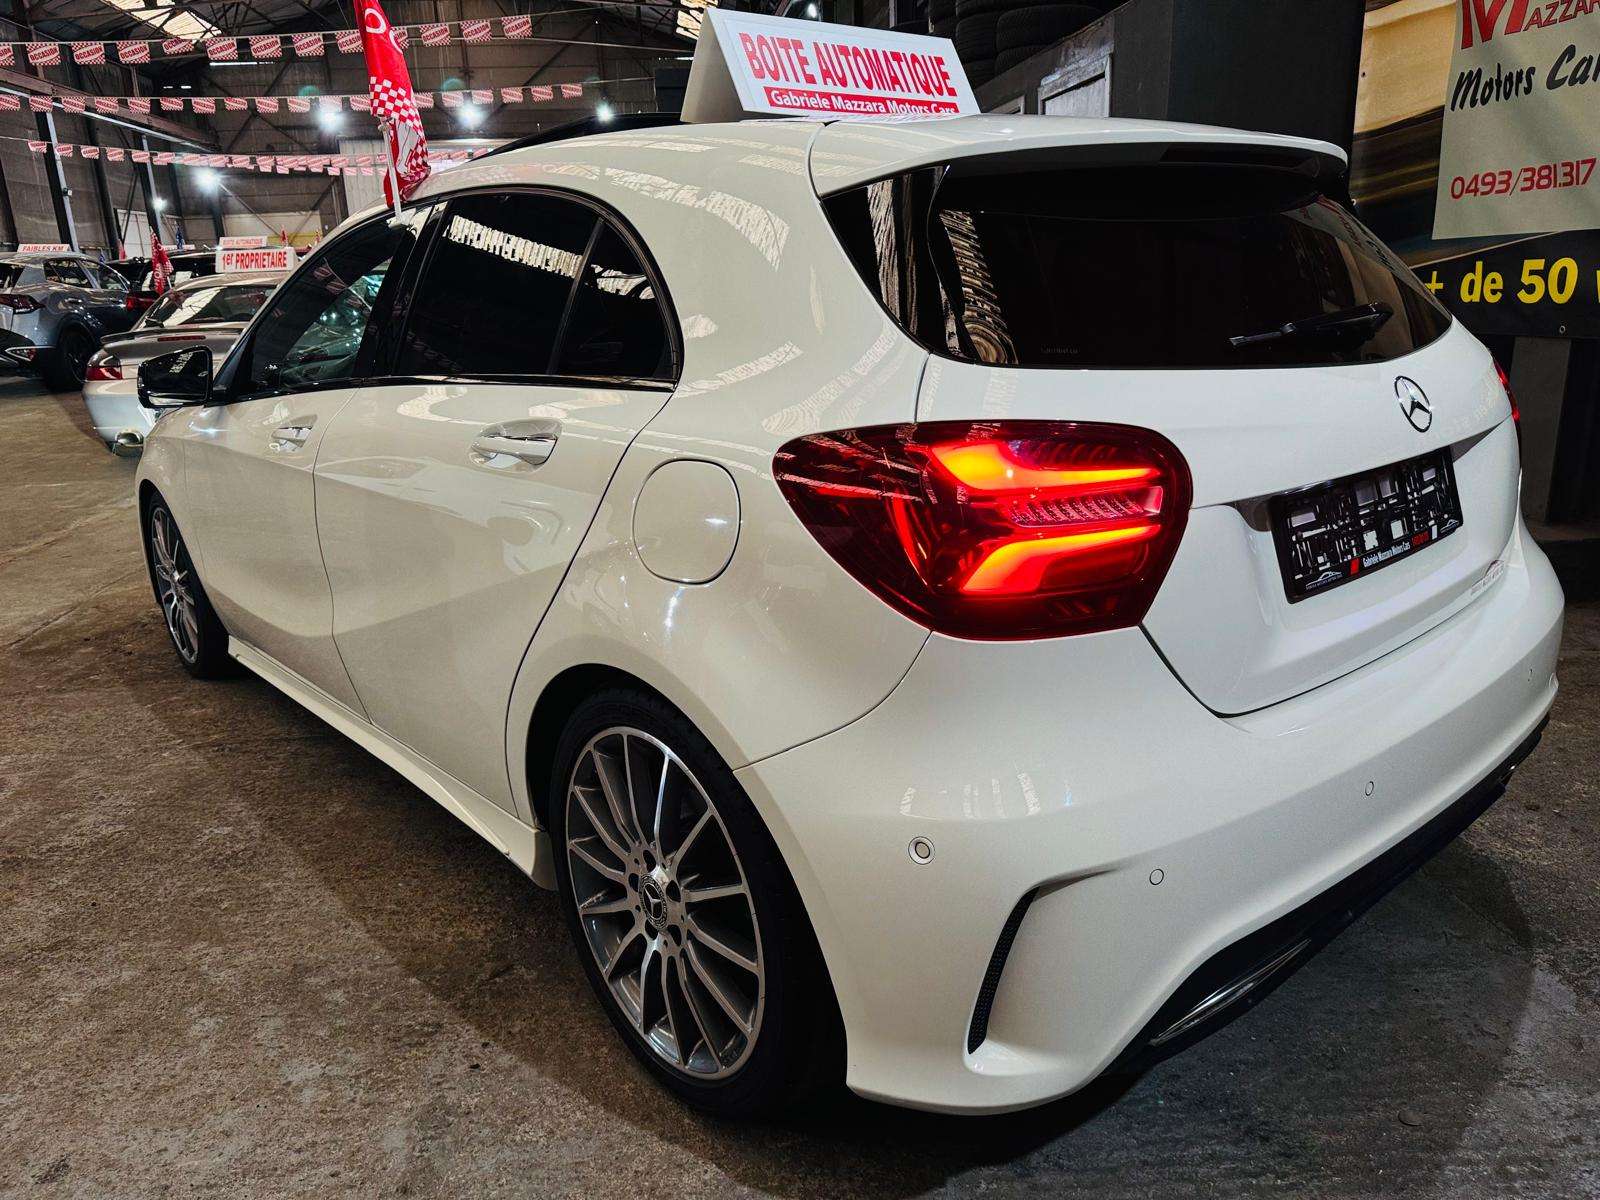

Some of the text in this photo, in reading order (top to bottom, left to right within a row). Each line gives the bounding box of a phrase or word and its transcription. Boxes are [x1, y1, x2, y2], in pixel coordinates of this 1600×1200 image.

[422, 27, 449, 42] OCCASION
[464, 24, 490, 39] OCCASION
[505, 20, 530, 34] OCCASION
[209, 42, 236, 56] OCCASION
[252, 40, 279, 54] OCCASION
[296, 37, 321, 52] OCCASION
[30, 46, 58, 61] OCCASION
[75, 46, 103, 60] OCCASION
[120, 46, 148, 60] OCCASION
[739, 32, 958, 98] BOITE AUTOMATIQUE
[1451, 63, 1536, 111] Motors
[770, 90, 956, 114] Gabriele Mazzara Motors Cars
[1451, 157, 1597, 200] 0493/381.317
[222, 251, 287, 270] 1er PROPRIETAIRE
[1460, 260, 1504, 303] de
[1517, 257, 1579, 304] 50
